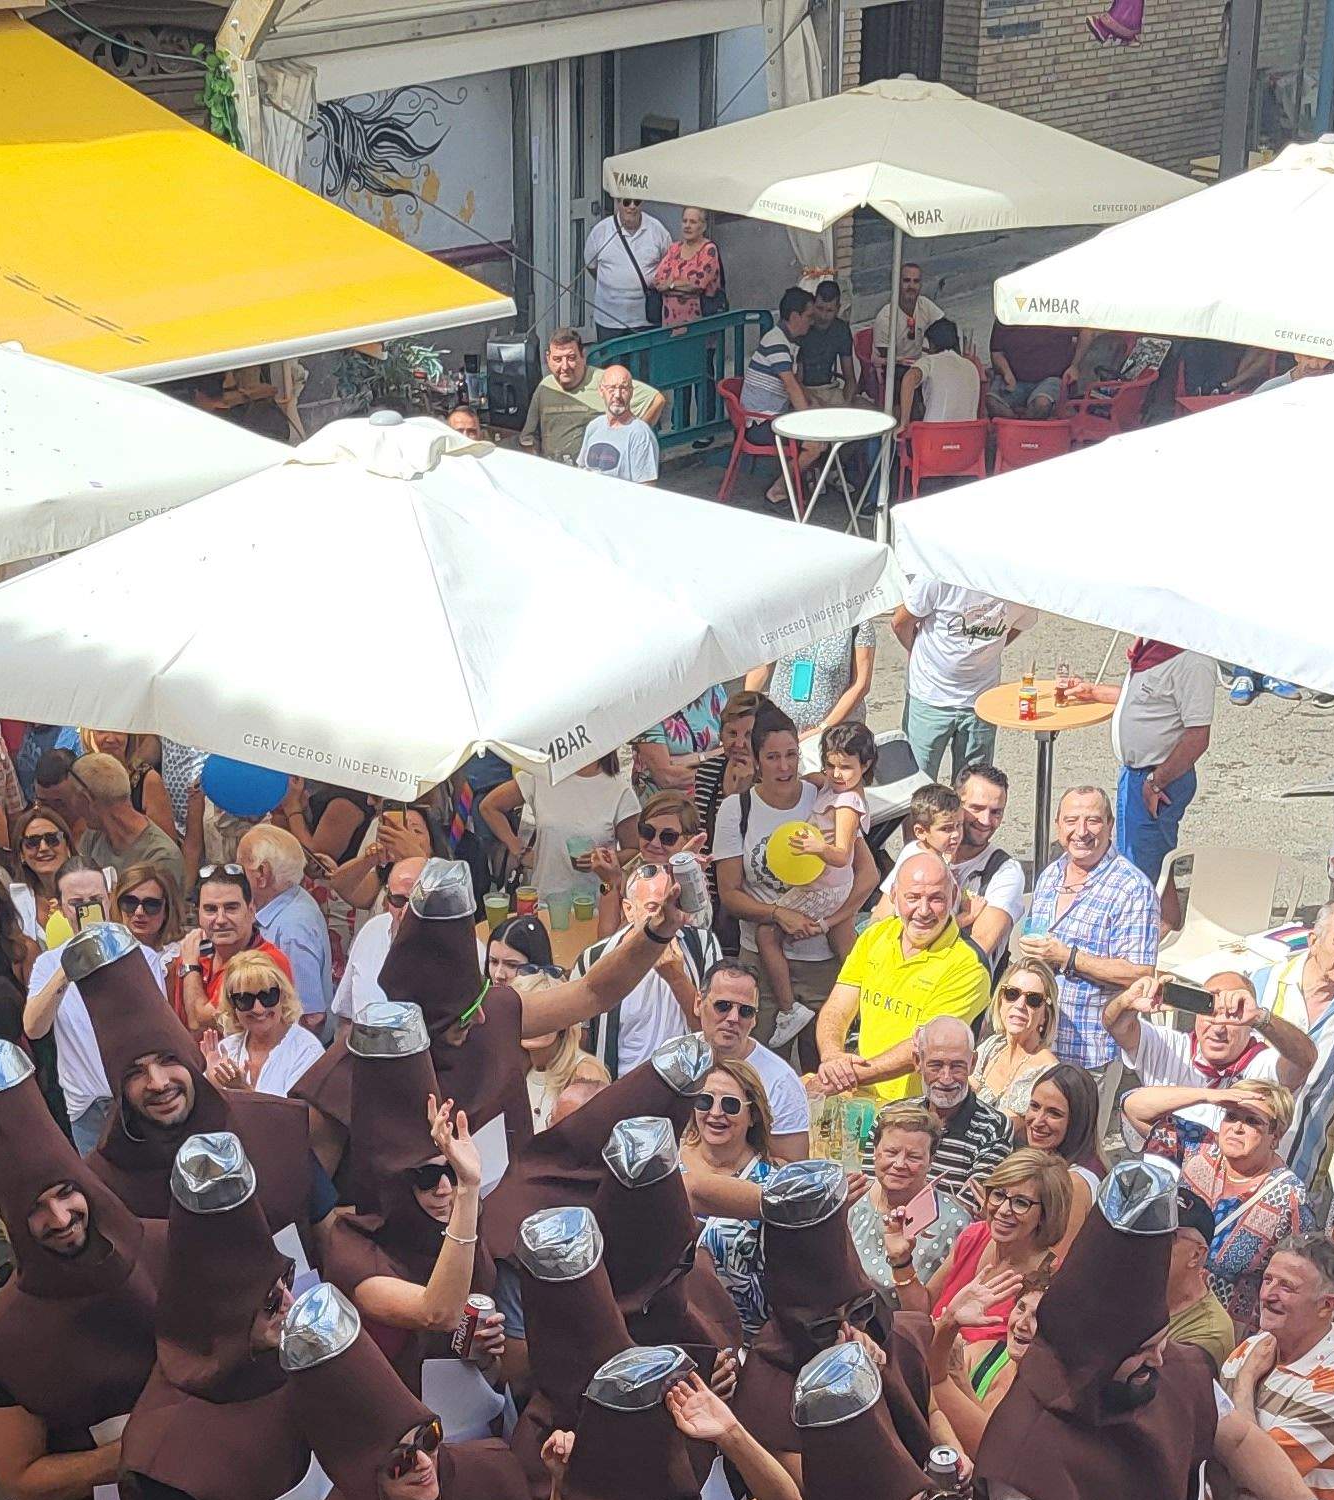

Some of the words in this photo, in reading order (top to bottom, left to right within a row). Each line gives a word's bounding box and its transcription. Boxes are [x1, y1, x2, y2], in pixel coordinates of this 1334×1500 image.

[618, 172, 648, 190] AMBAR
[1028, 298, 1080, 315] AMBAR
[760, 618, 813, 647] CERVECEROS
[811, 584, 885, 624] INDEPENDIENTES
[242, 732, 332, 766] CERVECEROS
[453, 1314, 472, 1355] AMBAR
